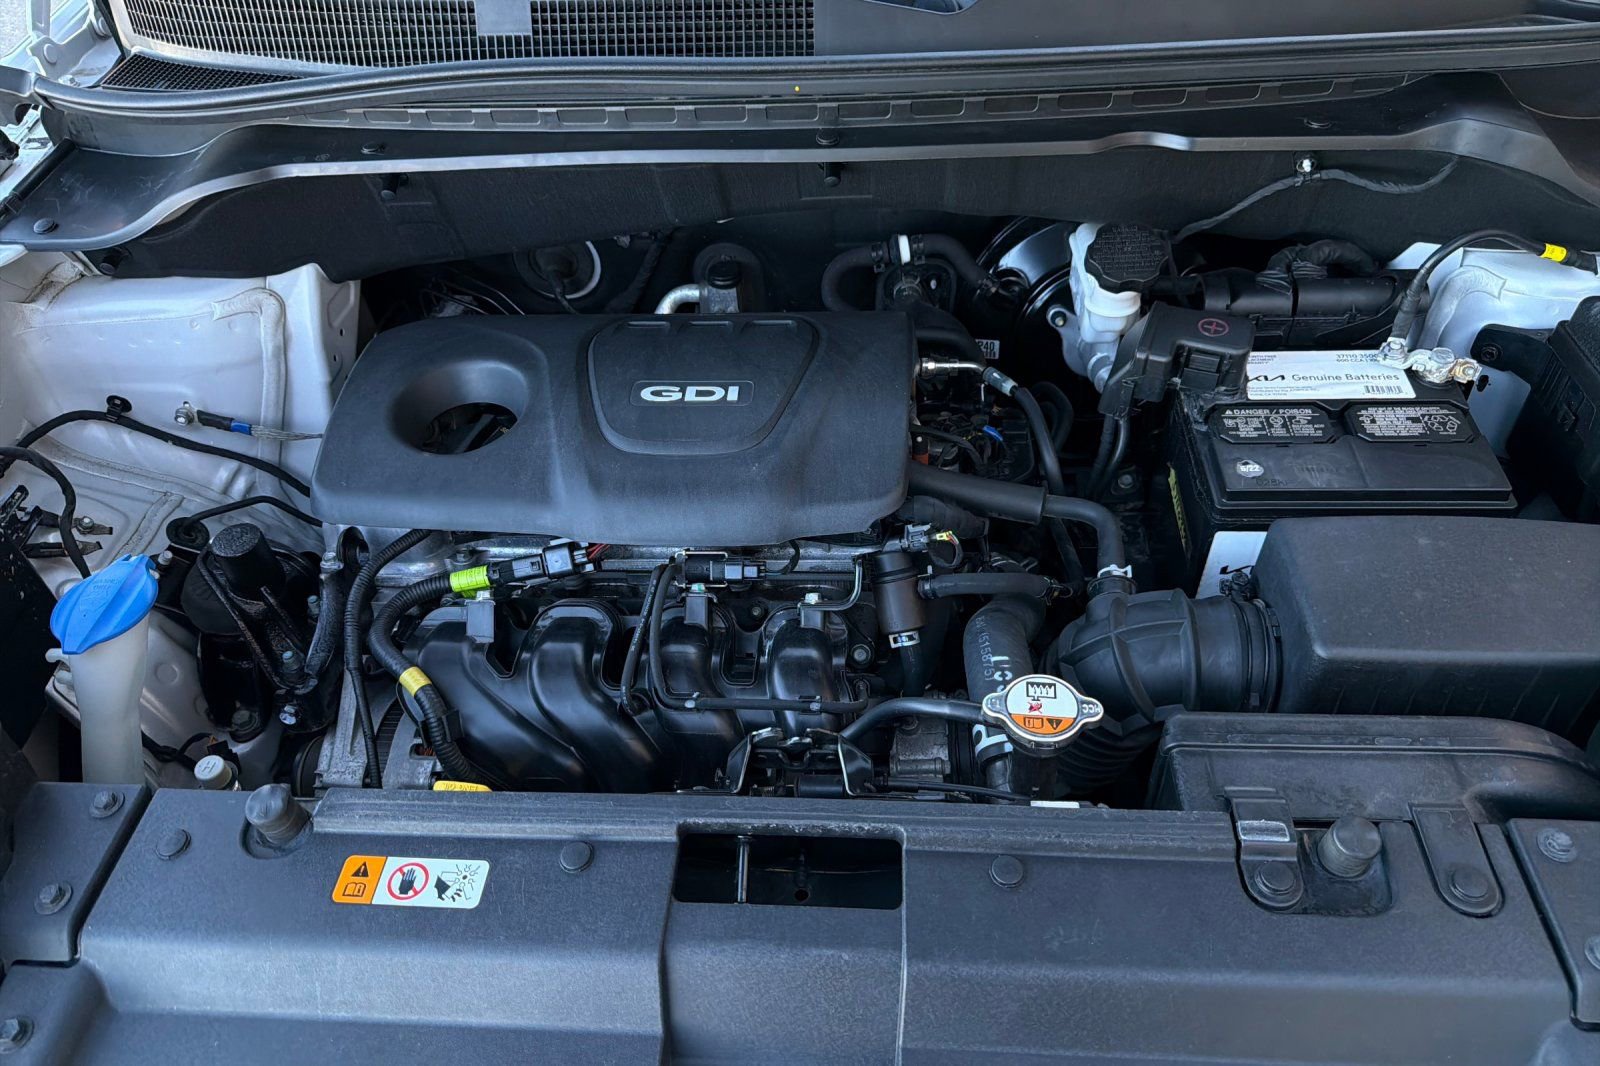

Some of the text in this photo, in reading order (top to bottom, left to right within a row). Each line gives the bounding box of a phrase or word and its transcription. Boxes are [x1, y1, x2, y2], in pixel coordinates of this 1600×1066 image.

[1345, 373, 1400, 381] Batteries
[640, 386, 739, 401] GDI
[1081, 703, 1101, 714] HCC
